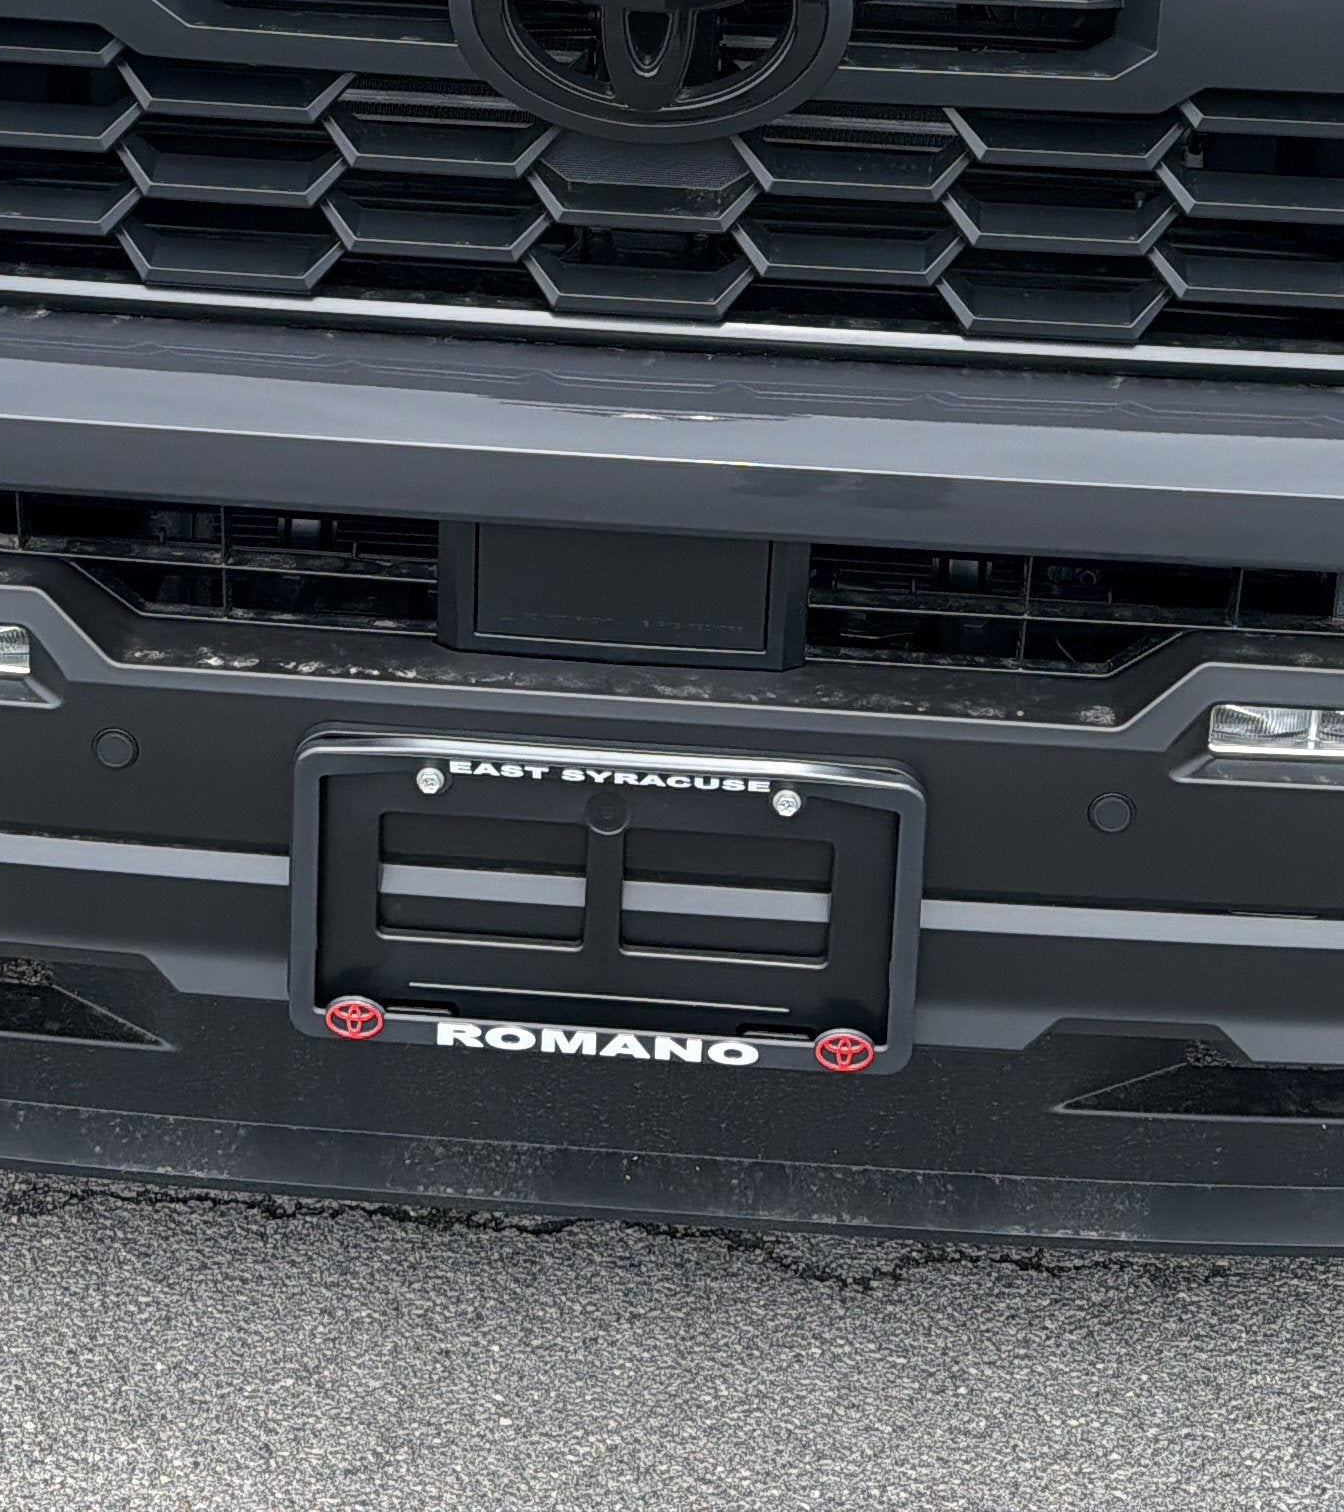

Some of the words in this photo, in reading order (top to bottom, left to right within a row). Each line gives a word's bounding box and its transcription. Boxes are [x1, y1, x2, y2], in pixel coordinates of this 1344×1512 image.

[449, 760, 549, 780] EAST
[561, 768, 771, 793] SYRACUSE
[436, 1021, 759, 1066] ROMANO
